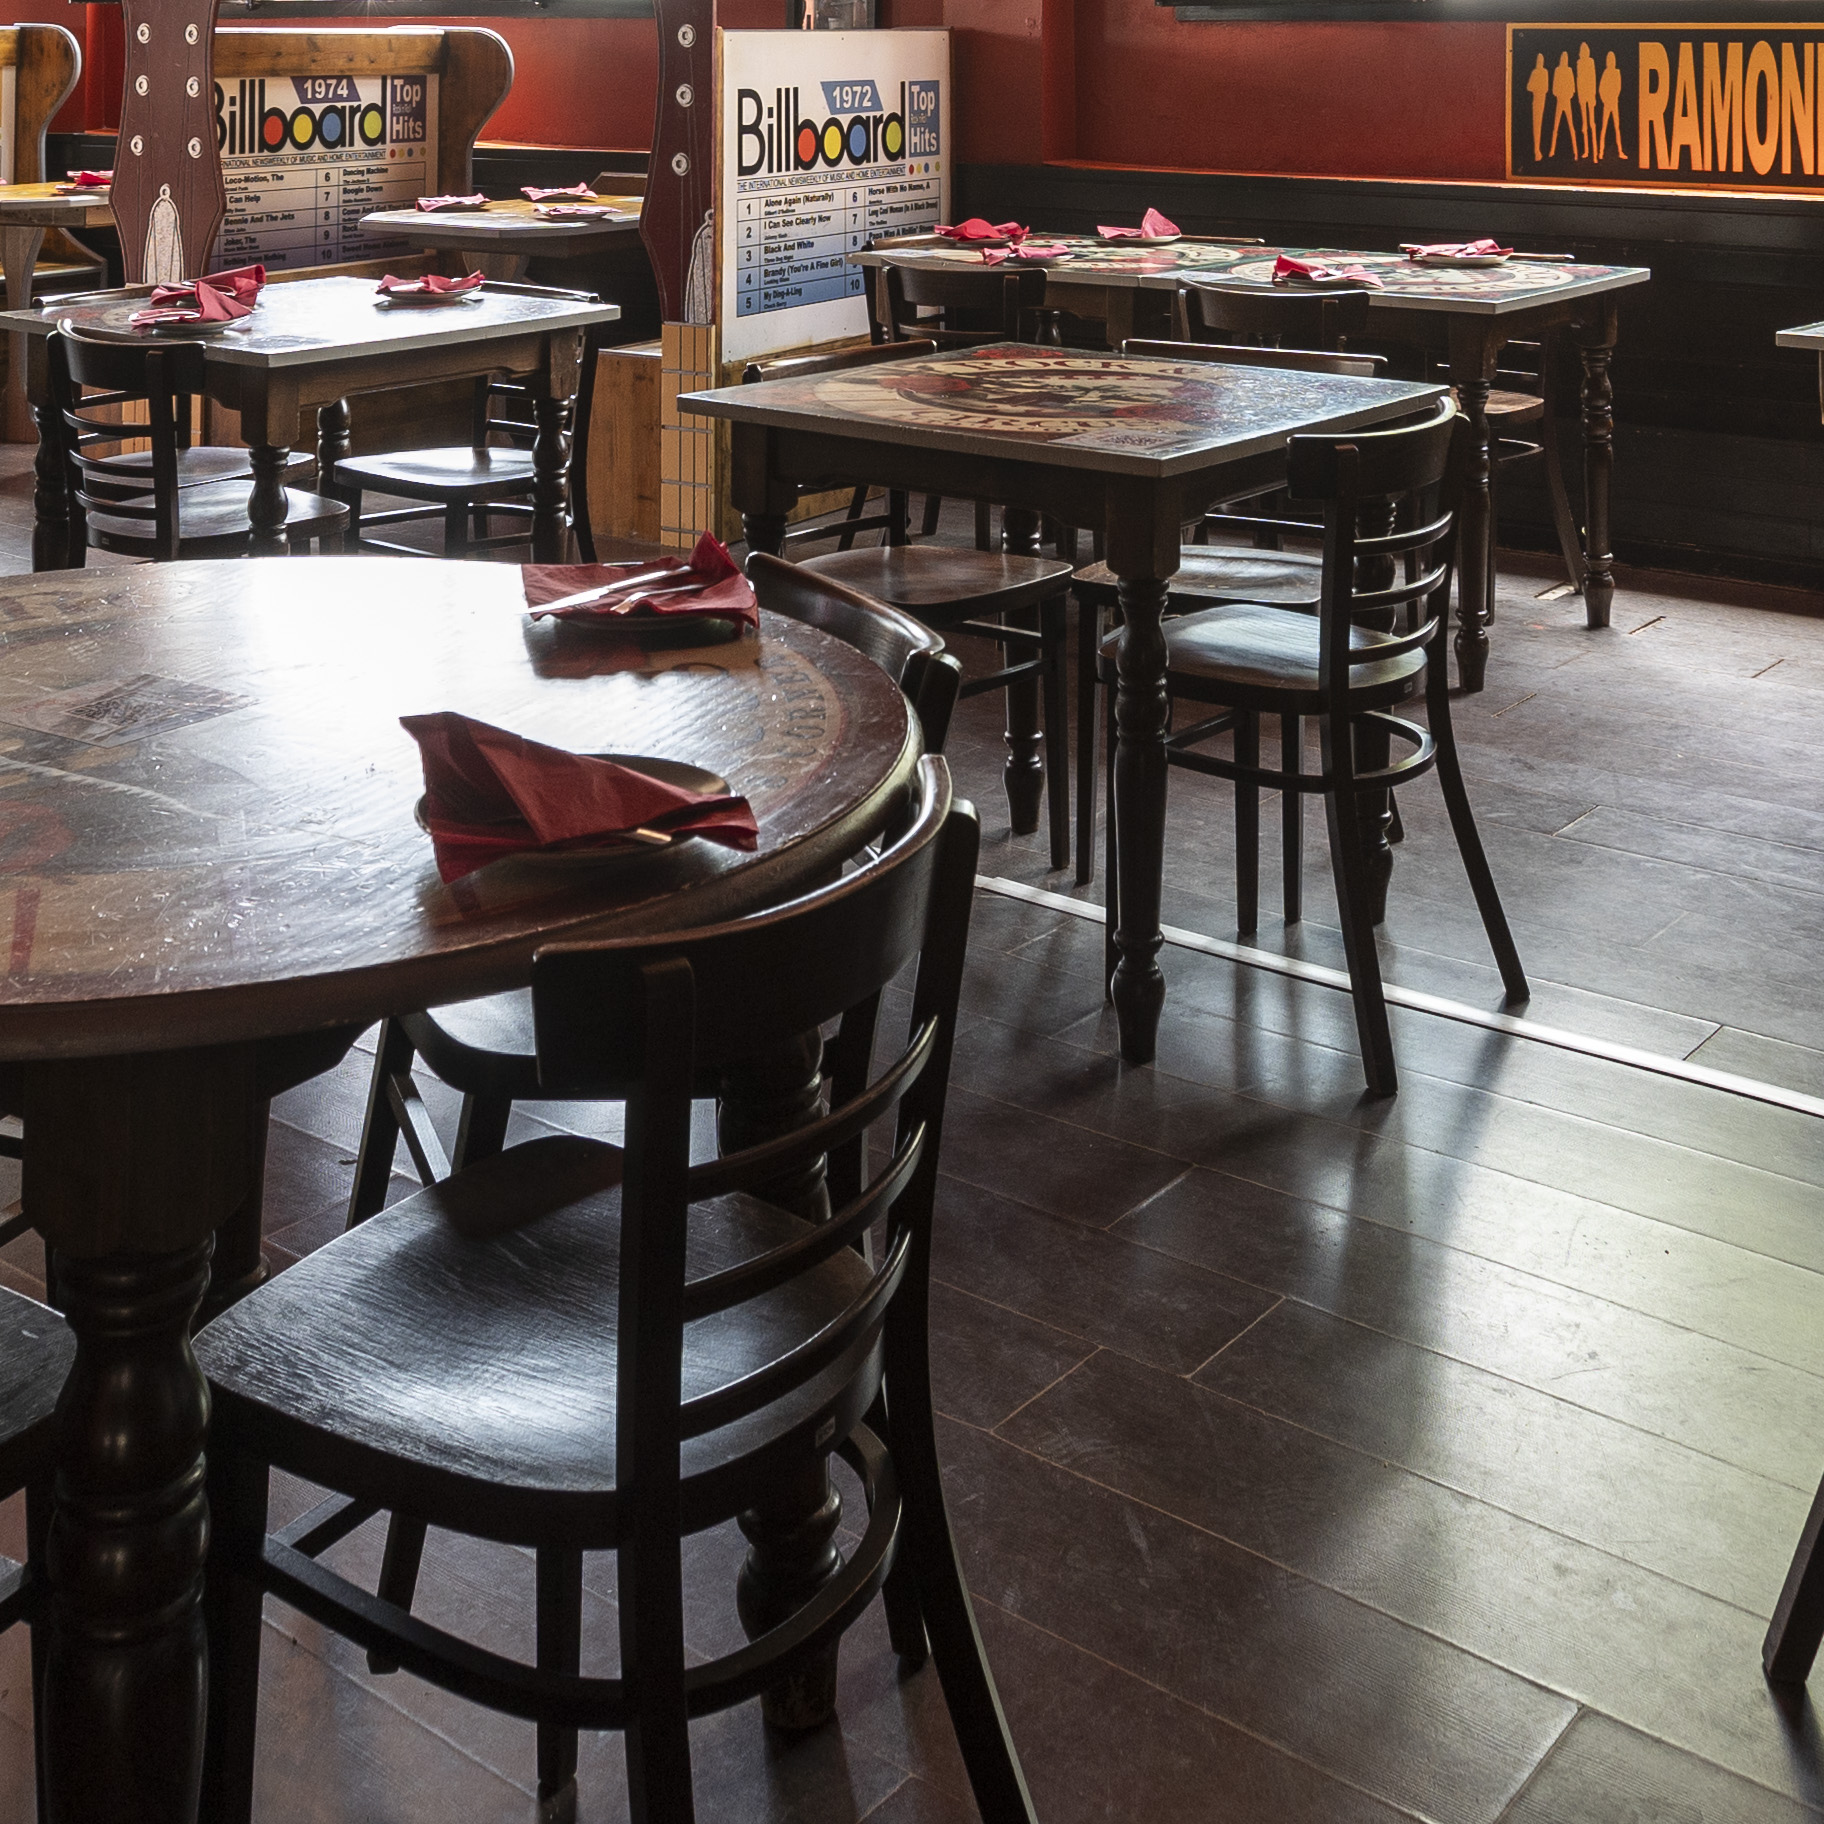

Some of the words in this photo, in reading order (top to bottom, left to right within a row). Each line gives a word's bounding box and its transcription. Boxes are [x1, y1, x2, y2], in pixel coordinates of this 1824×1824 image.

[303, 78, 349, 99] 1974
[393, 78, 421, 108] Top
[832, 84, 873, 110] 1972
[910, 84, 936, 117] Top
[392, 116, 423, 139] Hits
[737, 81, 906, 176] Billboard
[910, 126, 938, 154] Hits
[324, 172, 331, 182] 6
[737, 181, 747, 191] THE
[748, 178, 787, 190] INTERNATIONAL
[324, 191, 330, 202] 7
[852, 191, 858, 203] 6
[746, 203, 751, 215] 1
[324, 210, 330, 221] 8
[852, 213, 858, 225] 7
[323, 229, 330, 241] 9
[745, 226, 752, 239] 2
[852, 235, 858, 247] 8
[321, 248, 333, 260] 10
[745, 250, 752, 262] 3
[745, 273, 752, 286] 4
[850, 279, 860, 291] 10
[745, 297, 752, 309] 5
